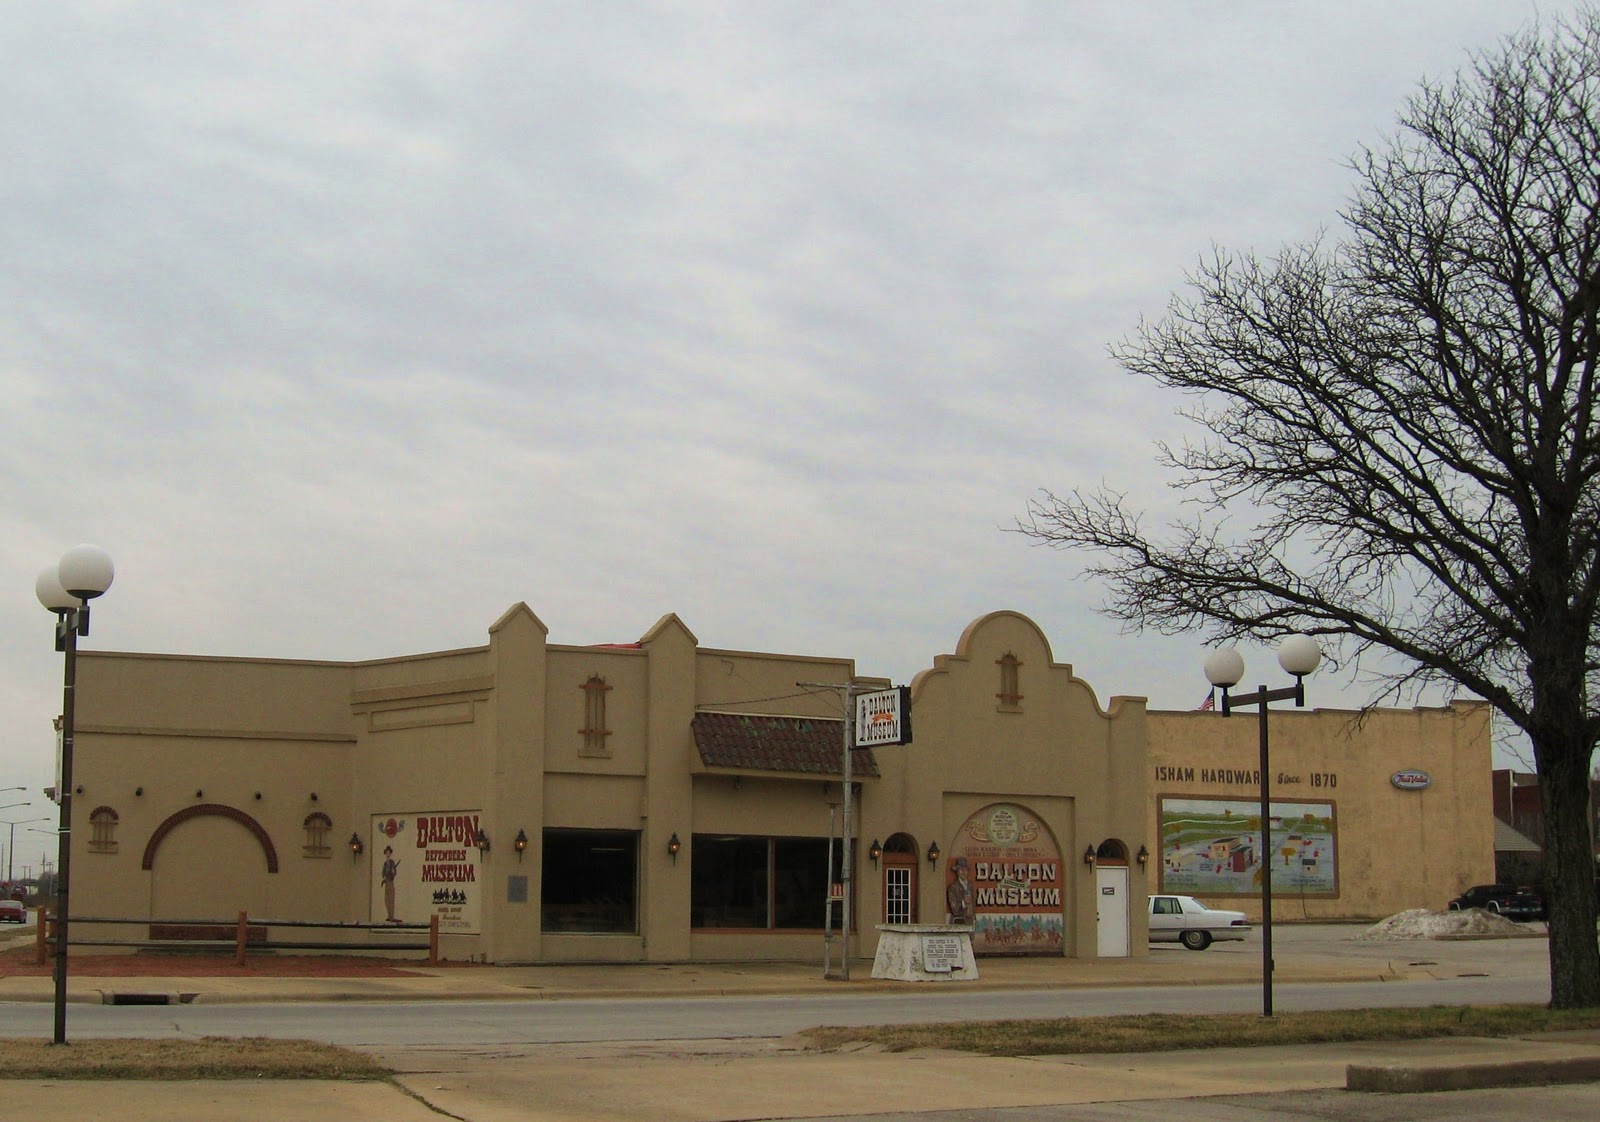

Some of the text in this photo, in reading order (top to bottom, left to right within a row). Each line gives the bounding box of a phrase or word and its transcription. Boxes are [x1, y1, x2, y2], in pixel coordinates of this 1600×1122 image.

[869, 694, 896, 715] DALTON
[866, 719, 898, 741] MUSEUM
[1155, 766, 1337, 788] ISHAM HARDWAR Since 1870
[417, 815, 479, 848] DALTON
[425, 850, 466, 861] DEFENDERS
[422, 864, 475, 882] MUSEUM
[975, 862, 1057, 882] DALTON
[976, 887, 1060, 907] MUSEUM
